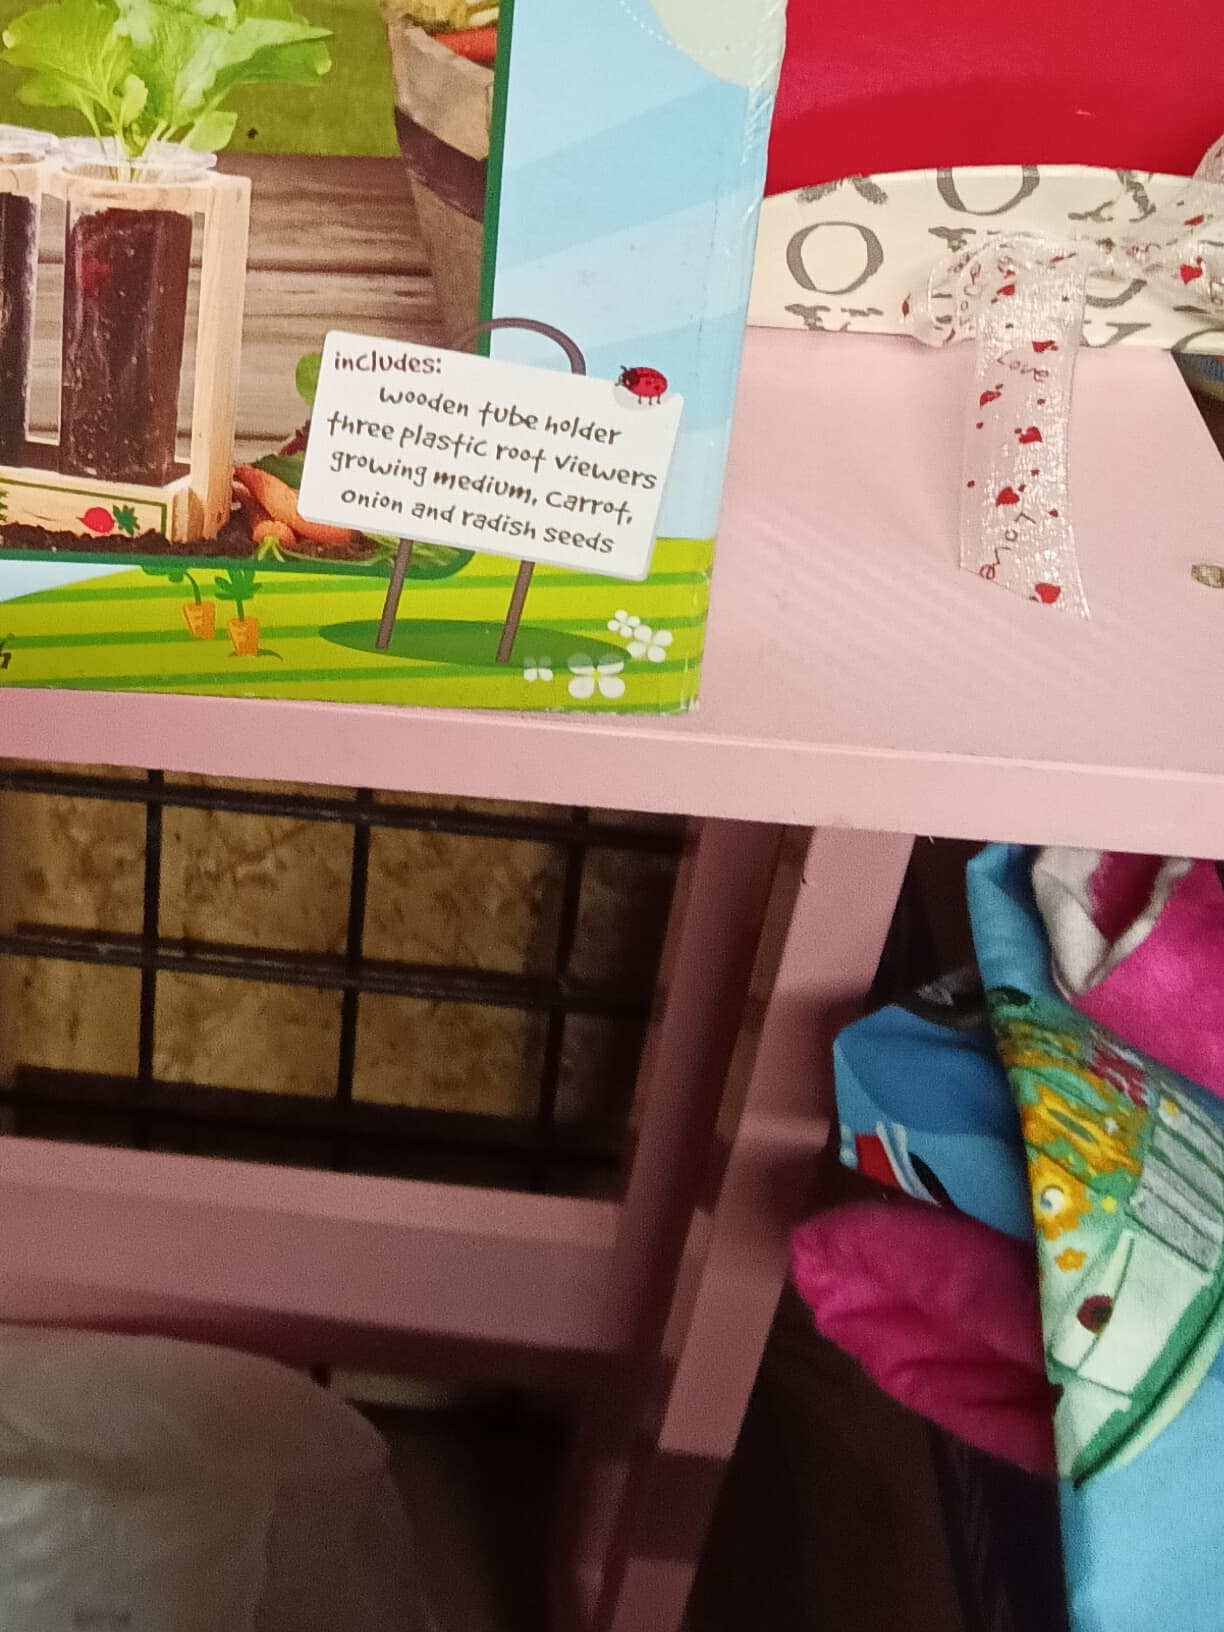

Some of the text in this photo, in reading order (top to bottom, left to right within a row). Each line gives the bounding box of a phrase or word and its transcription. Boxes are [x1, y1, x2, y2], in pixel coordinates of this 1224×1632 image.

[334, 350, 443, 375] includes:
[379, 386, 623, 446] wooden tube holder
[327, 411, 659, 490] three plastic root viewers
[330, 450, 428, 488] growing
[432, 470, 539, 507] medium,
[340, 488, 615, 554] onion and radish seeds
